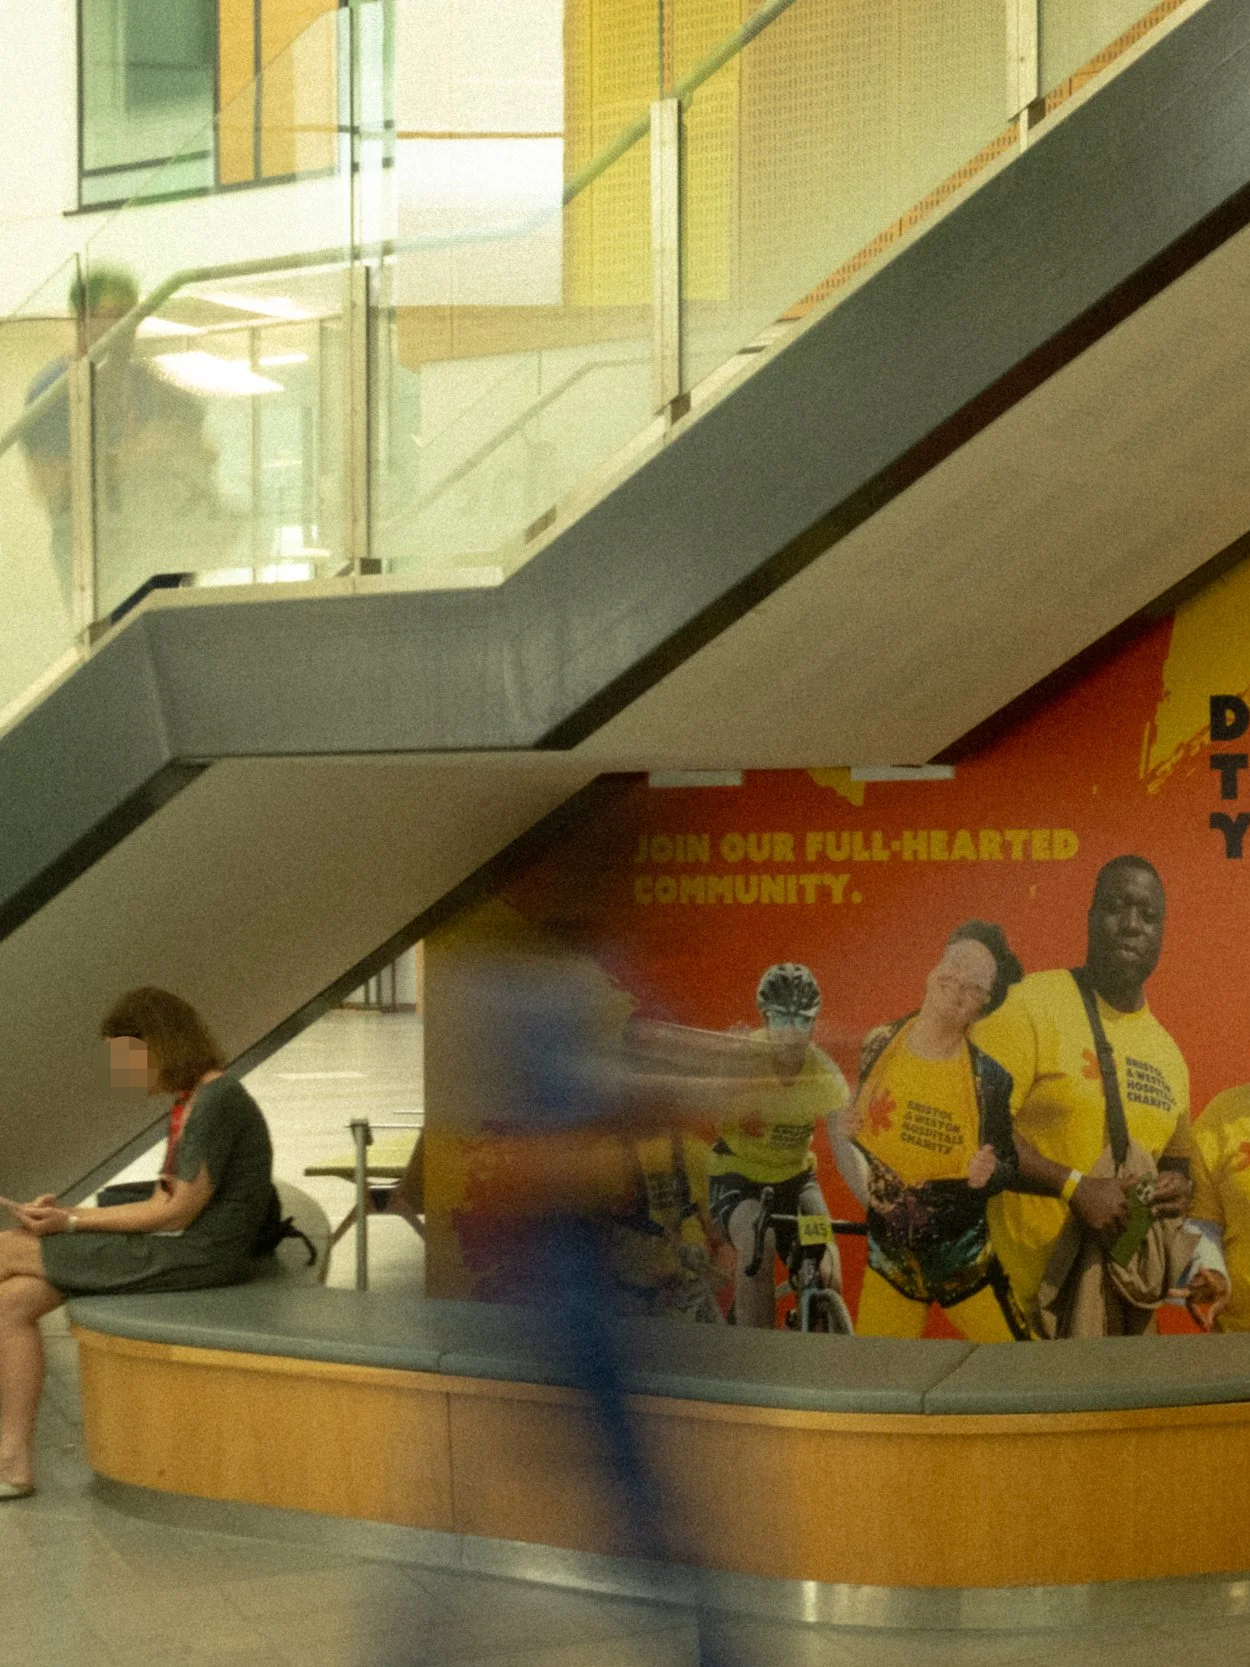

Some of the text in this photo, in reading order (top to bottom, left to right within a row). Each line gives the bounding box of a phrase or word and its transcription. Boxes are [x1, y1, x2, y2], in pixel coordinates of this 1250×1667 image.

[634, 828, 1080, 863] JOIN OUR FULL-HEARTED
[634, 874, 862, 905] COMMUNITY.
